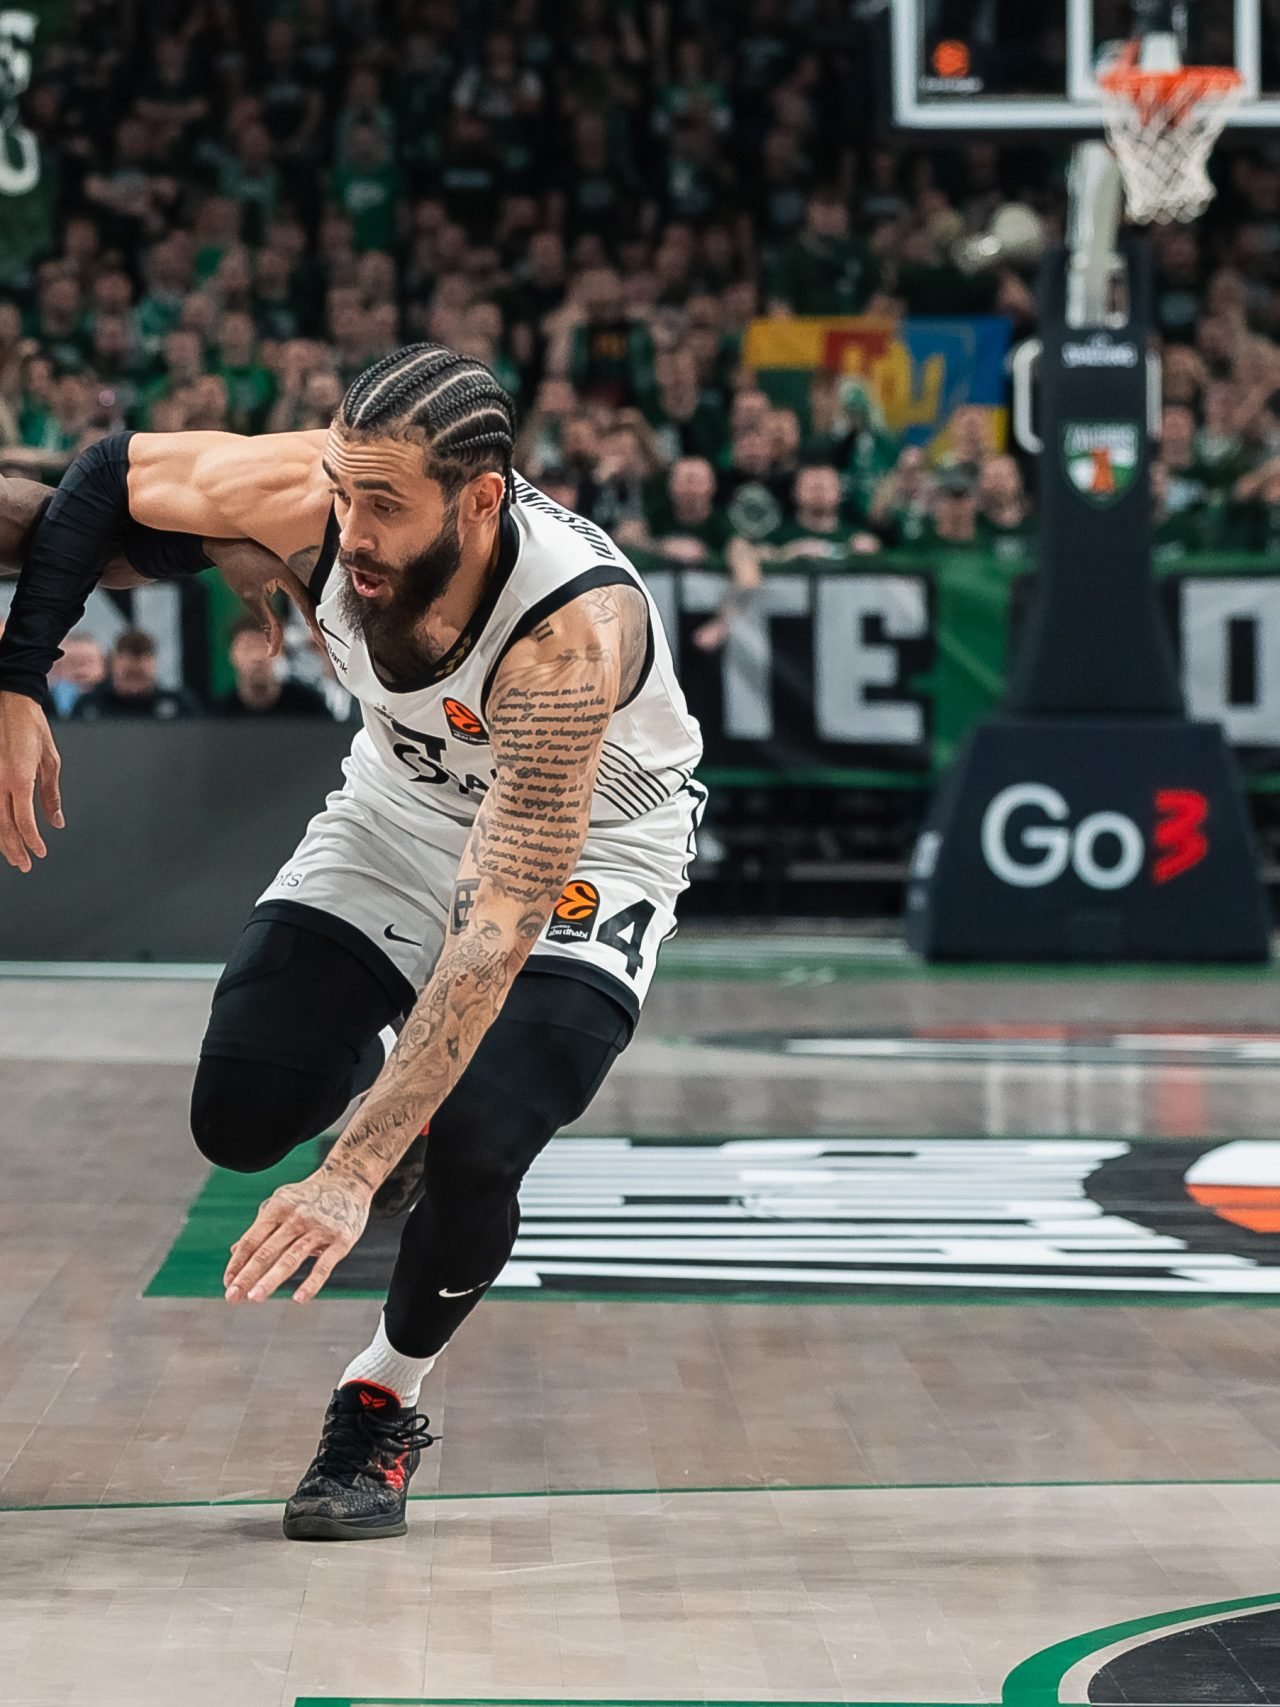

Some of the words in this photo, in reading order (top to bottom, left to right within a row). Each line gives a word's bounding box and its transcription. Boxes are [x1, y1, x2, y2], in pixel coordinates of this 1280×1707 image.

[981, 782, 1209, 891] Go3
[563, 928, 589, 939] dhabi
[596, 897, 657, 981] 4
